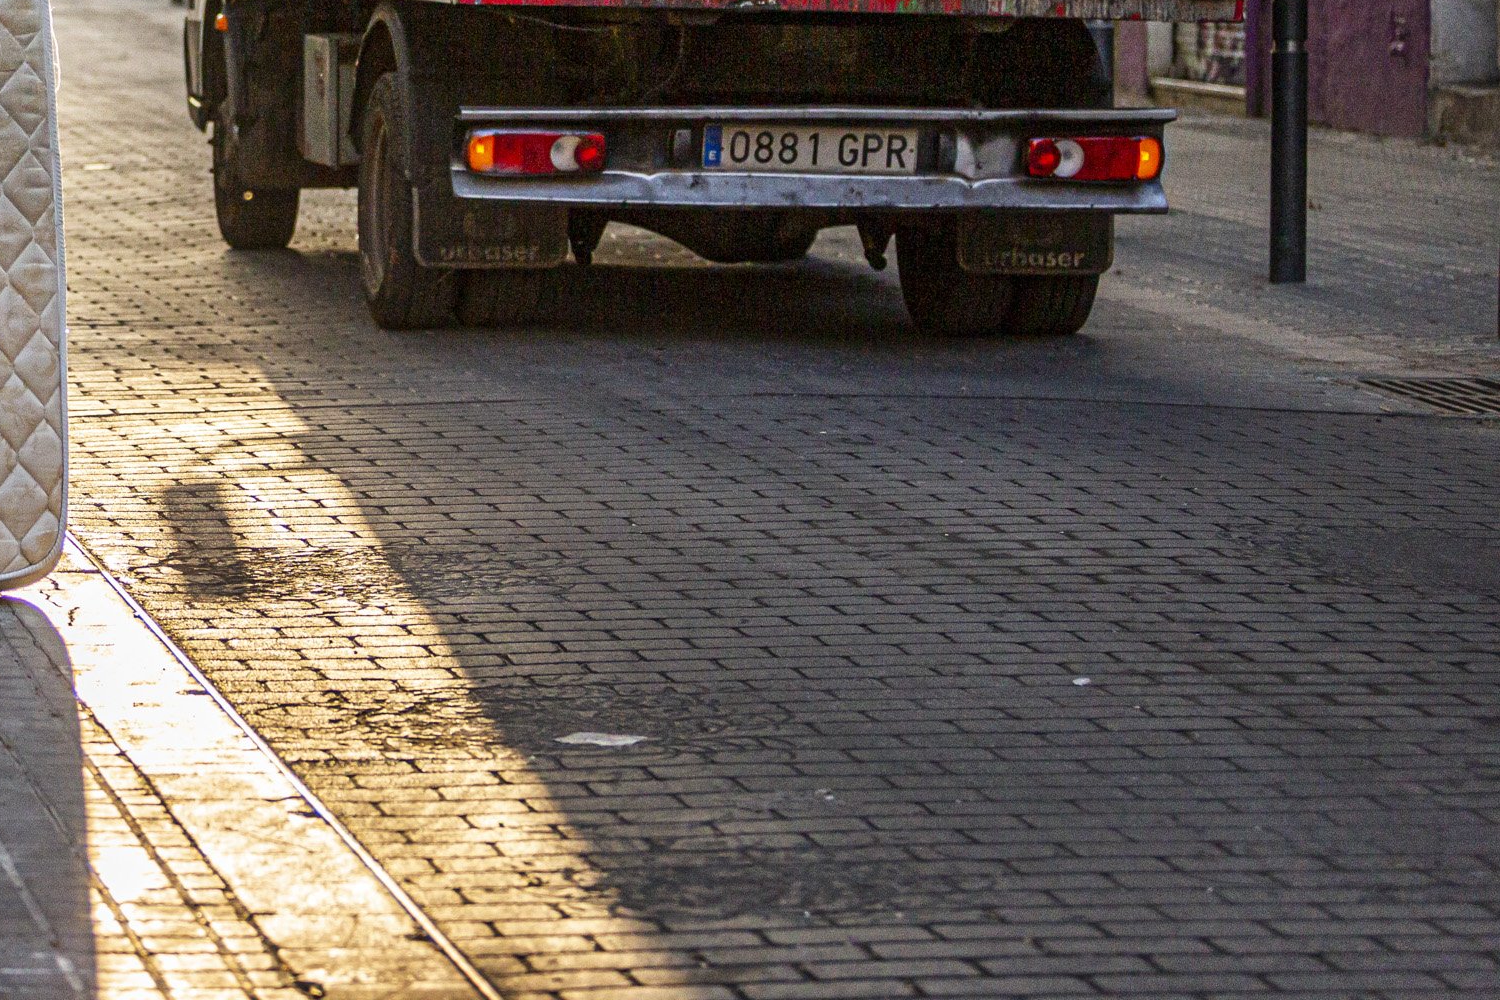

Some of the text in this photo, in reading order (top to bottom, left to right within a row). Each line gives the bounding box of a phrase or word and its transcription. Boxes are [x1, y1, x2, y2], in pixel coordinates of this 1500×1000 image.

[707, 150, 717, 161] E
[729, 130, 908, 169] 0881 GPR
